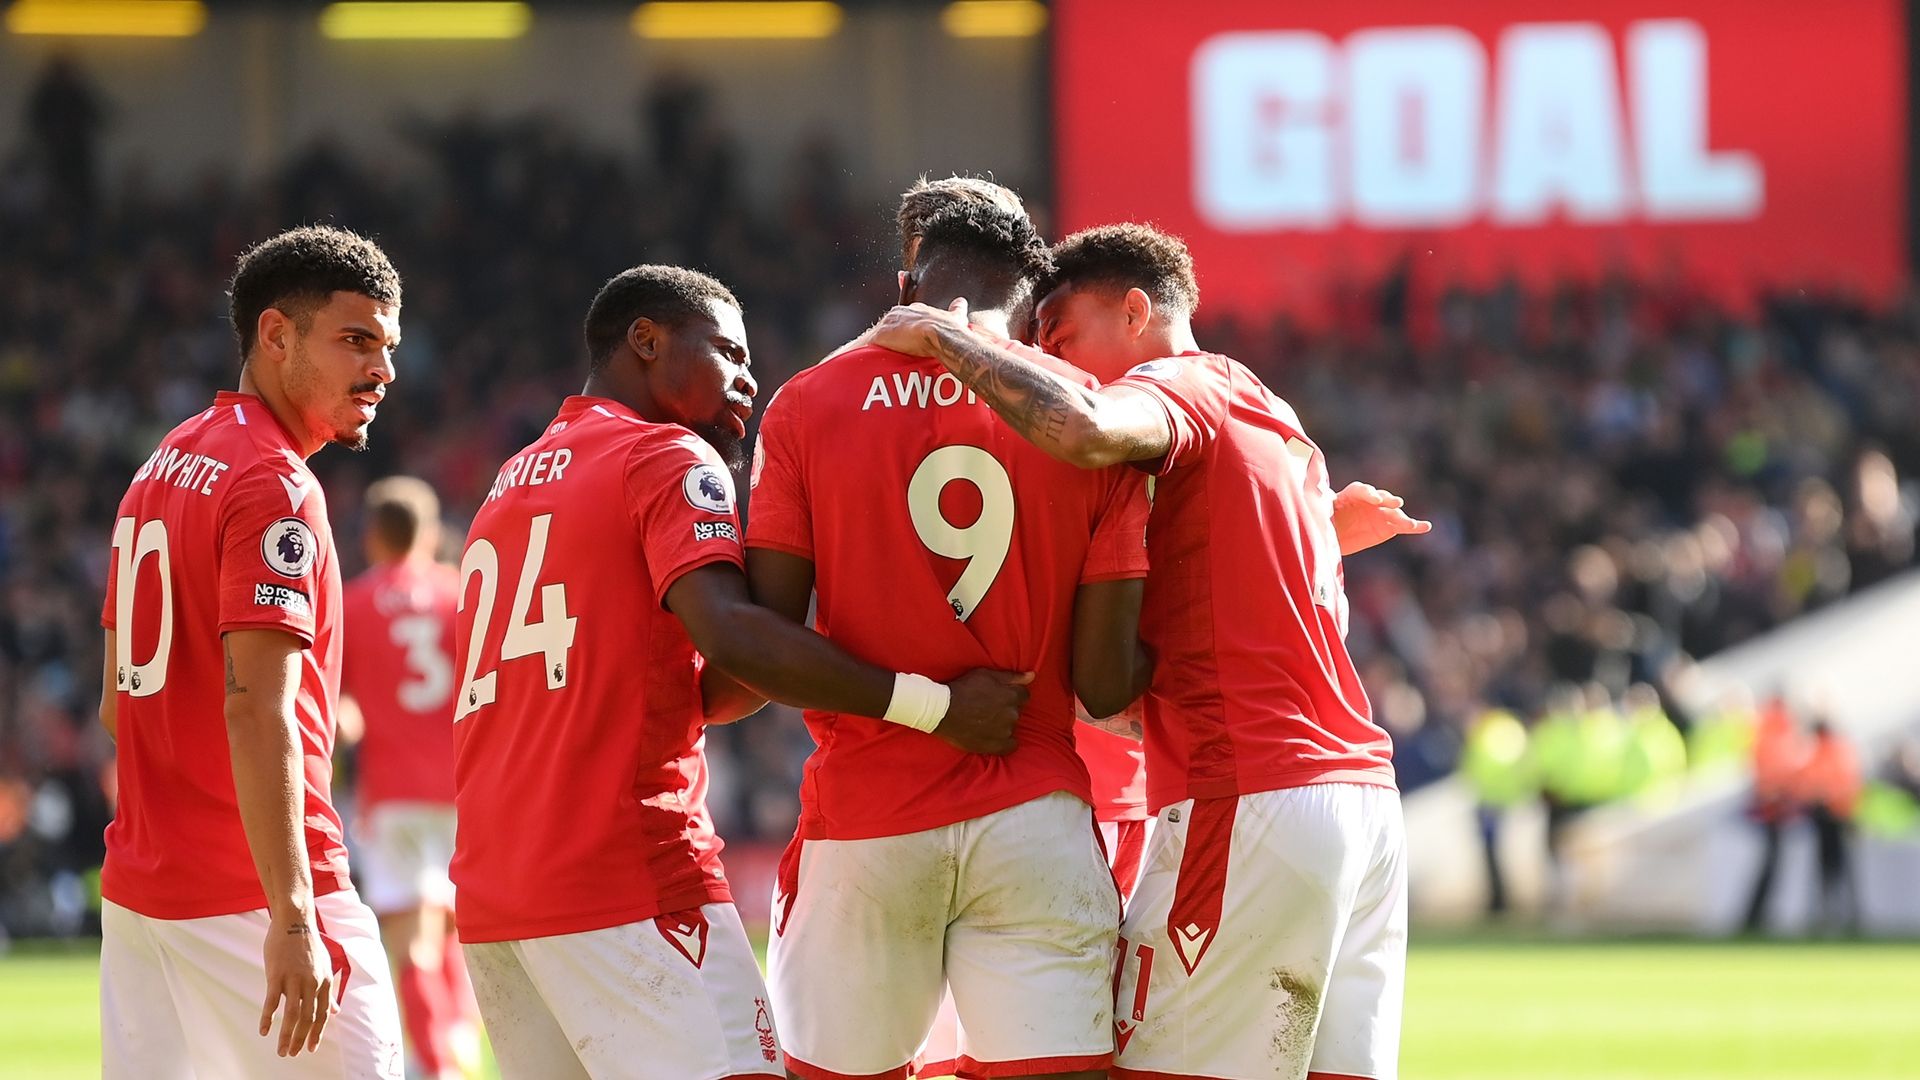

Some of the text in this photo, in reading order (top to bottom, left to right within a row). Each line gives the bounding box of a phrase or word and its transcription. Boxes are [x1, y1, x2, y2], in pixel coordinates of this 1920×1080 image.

[1190, 18, 1766, 233] GOAL
[694, 522, 713, 533] No
[695, 530, 714, 541] for
[907, 444, 1015, 623] 9
[112, 516, 173, 697] 10
[254, 594, 273, 605] for
[255, 583, 275, 596] No
[453, 513, 578, 724] 24
[388, 614, 456, 713] 3
